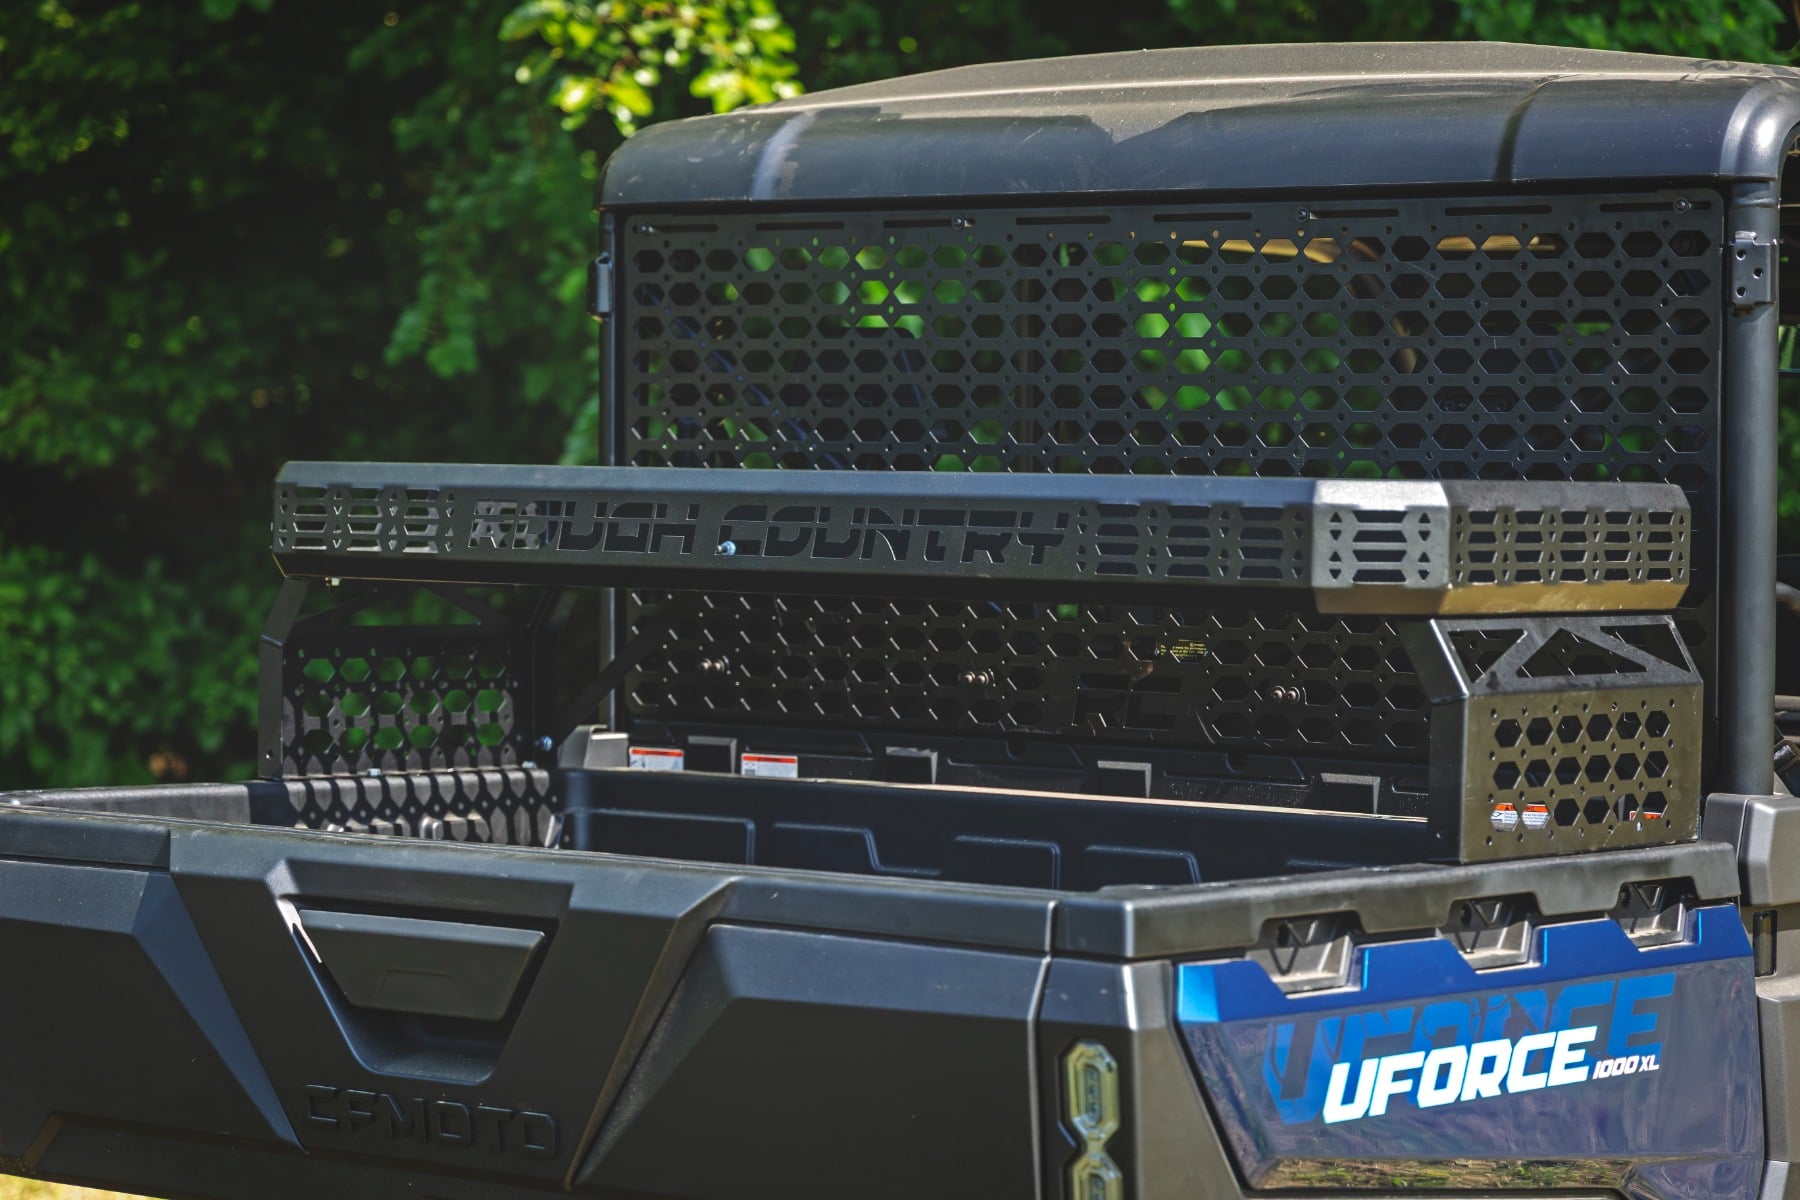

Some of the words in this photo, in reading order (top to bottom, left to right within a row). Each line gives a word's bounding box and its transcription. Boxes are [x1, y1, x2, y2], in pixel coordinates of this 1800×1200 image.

[467, 499, 700, 555] ROUGH
[713, 504, 1071, 565] COUNTRY
[1323, 1025, 1598, 1124] UFORCE
[1592, 1055, 1640, 1080] 1000
[1639, 1054, 1660, 1073] XL
[303, 1084, 557, 1157] CFMOTO
